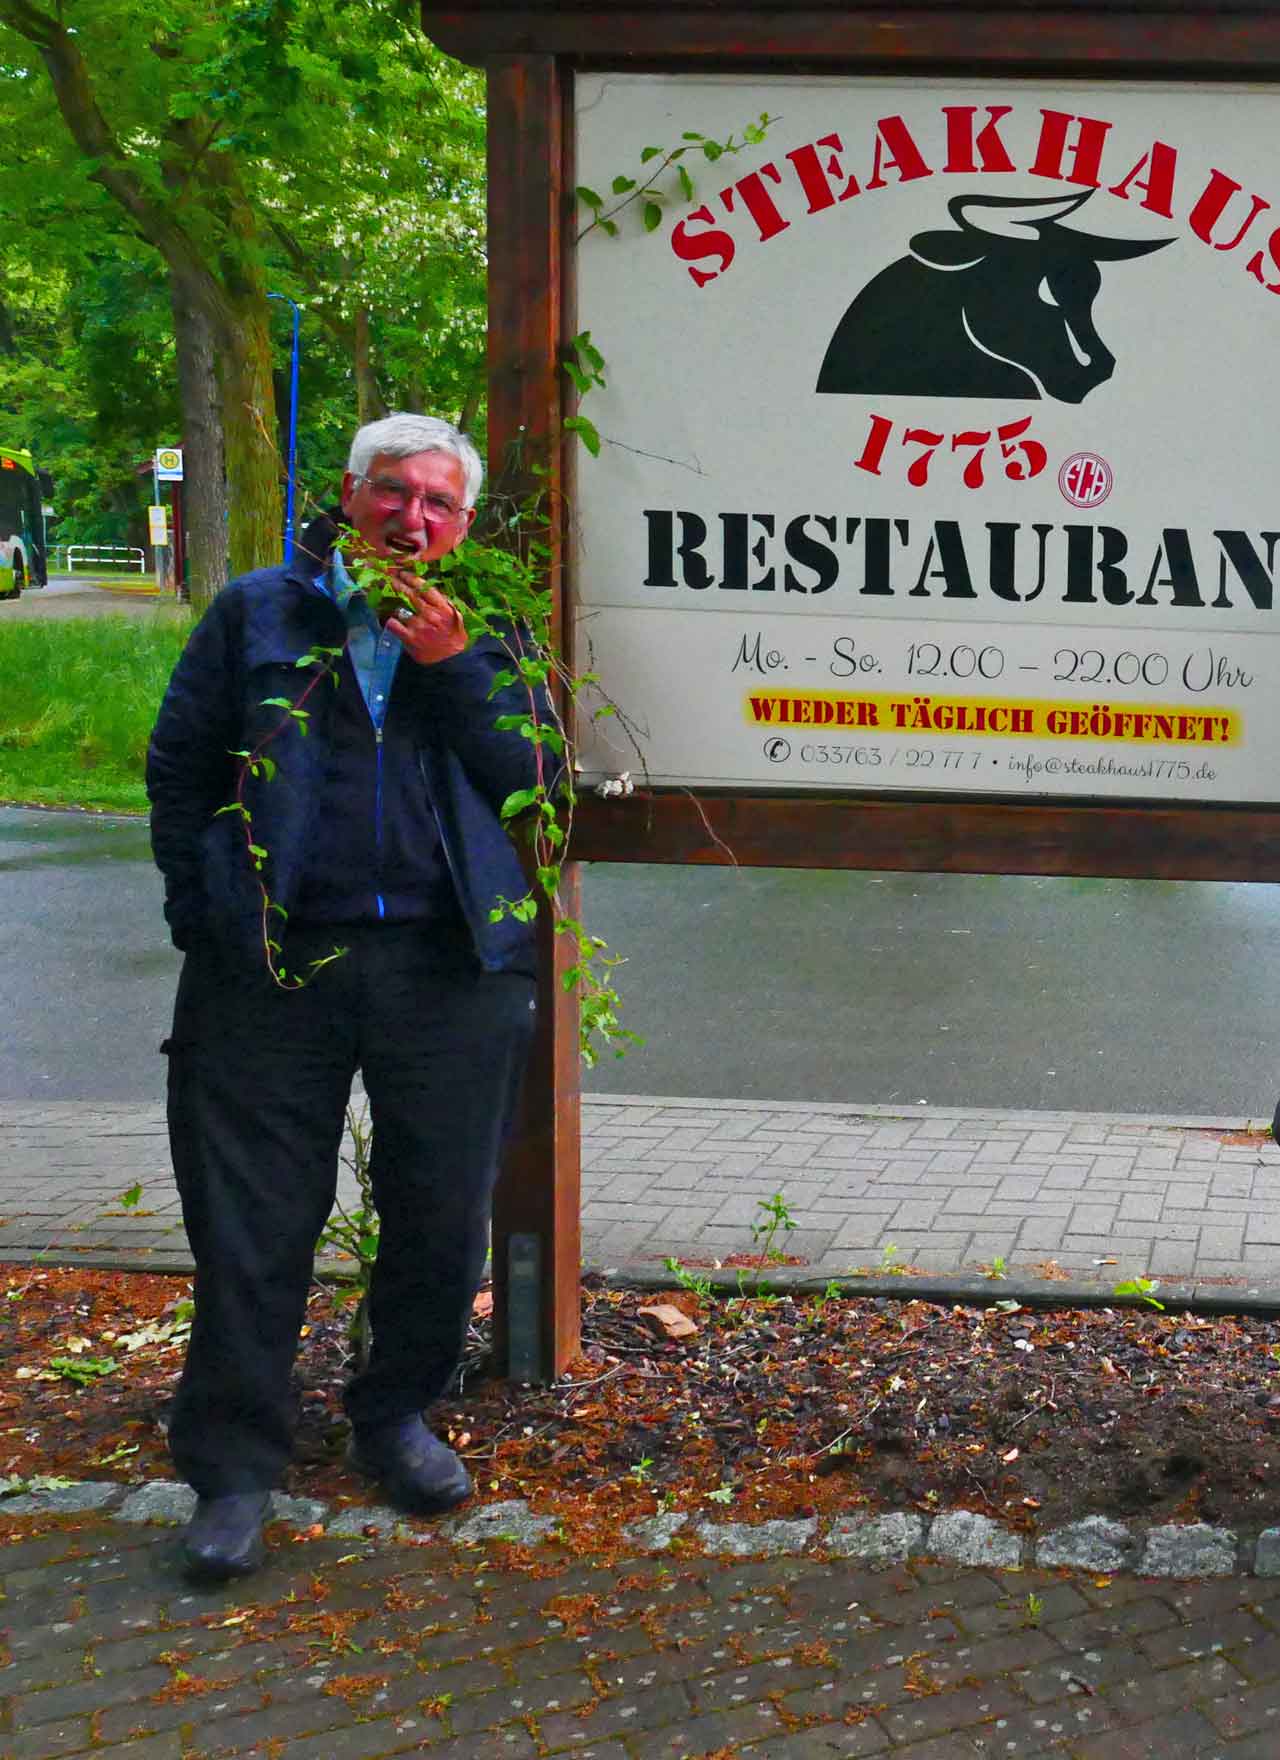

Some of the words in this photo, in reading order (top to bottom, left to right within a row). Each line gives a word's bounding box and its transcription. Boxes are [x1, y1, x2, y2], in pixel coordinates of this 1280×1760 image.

[854, 414, 1048, 489] 1775
[732, 632, 789, 674] Mo.
[830, 637, 882, 676] So.
[907, 643, 1005, 678] 12.00
[1053, 649, 1169, 686] 22.00
[1182, 648, 1254, 692] Uhr
[749, 697, 880, 726] WIEDER
[891, 697, 1034, 733] TÄGLICH
[1046, 704, 1230, 741] GEÖFFNET!
[800, 744, 882, 766] 033763
[1008, 756, 1217, 781] info@steakhaus1775.de
